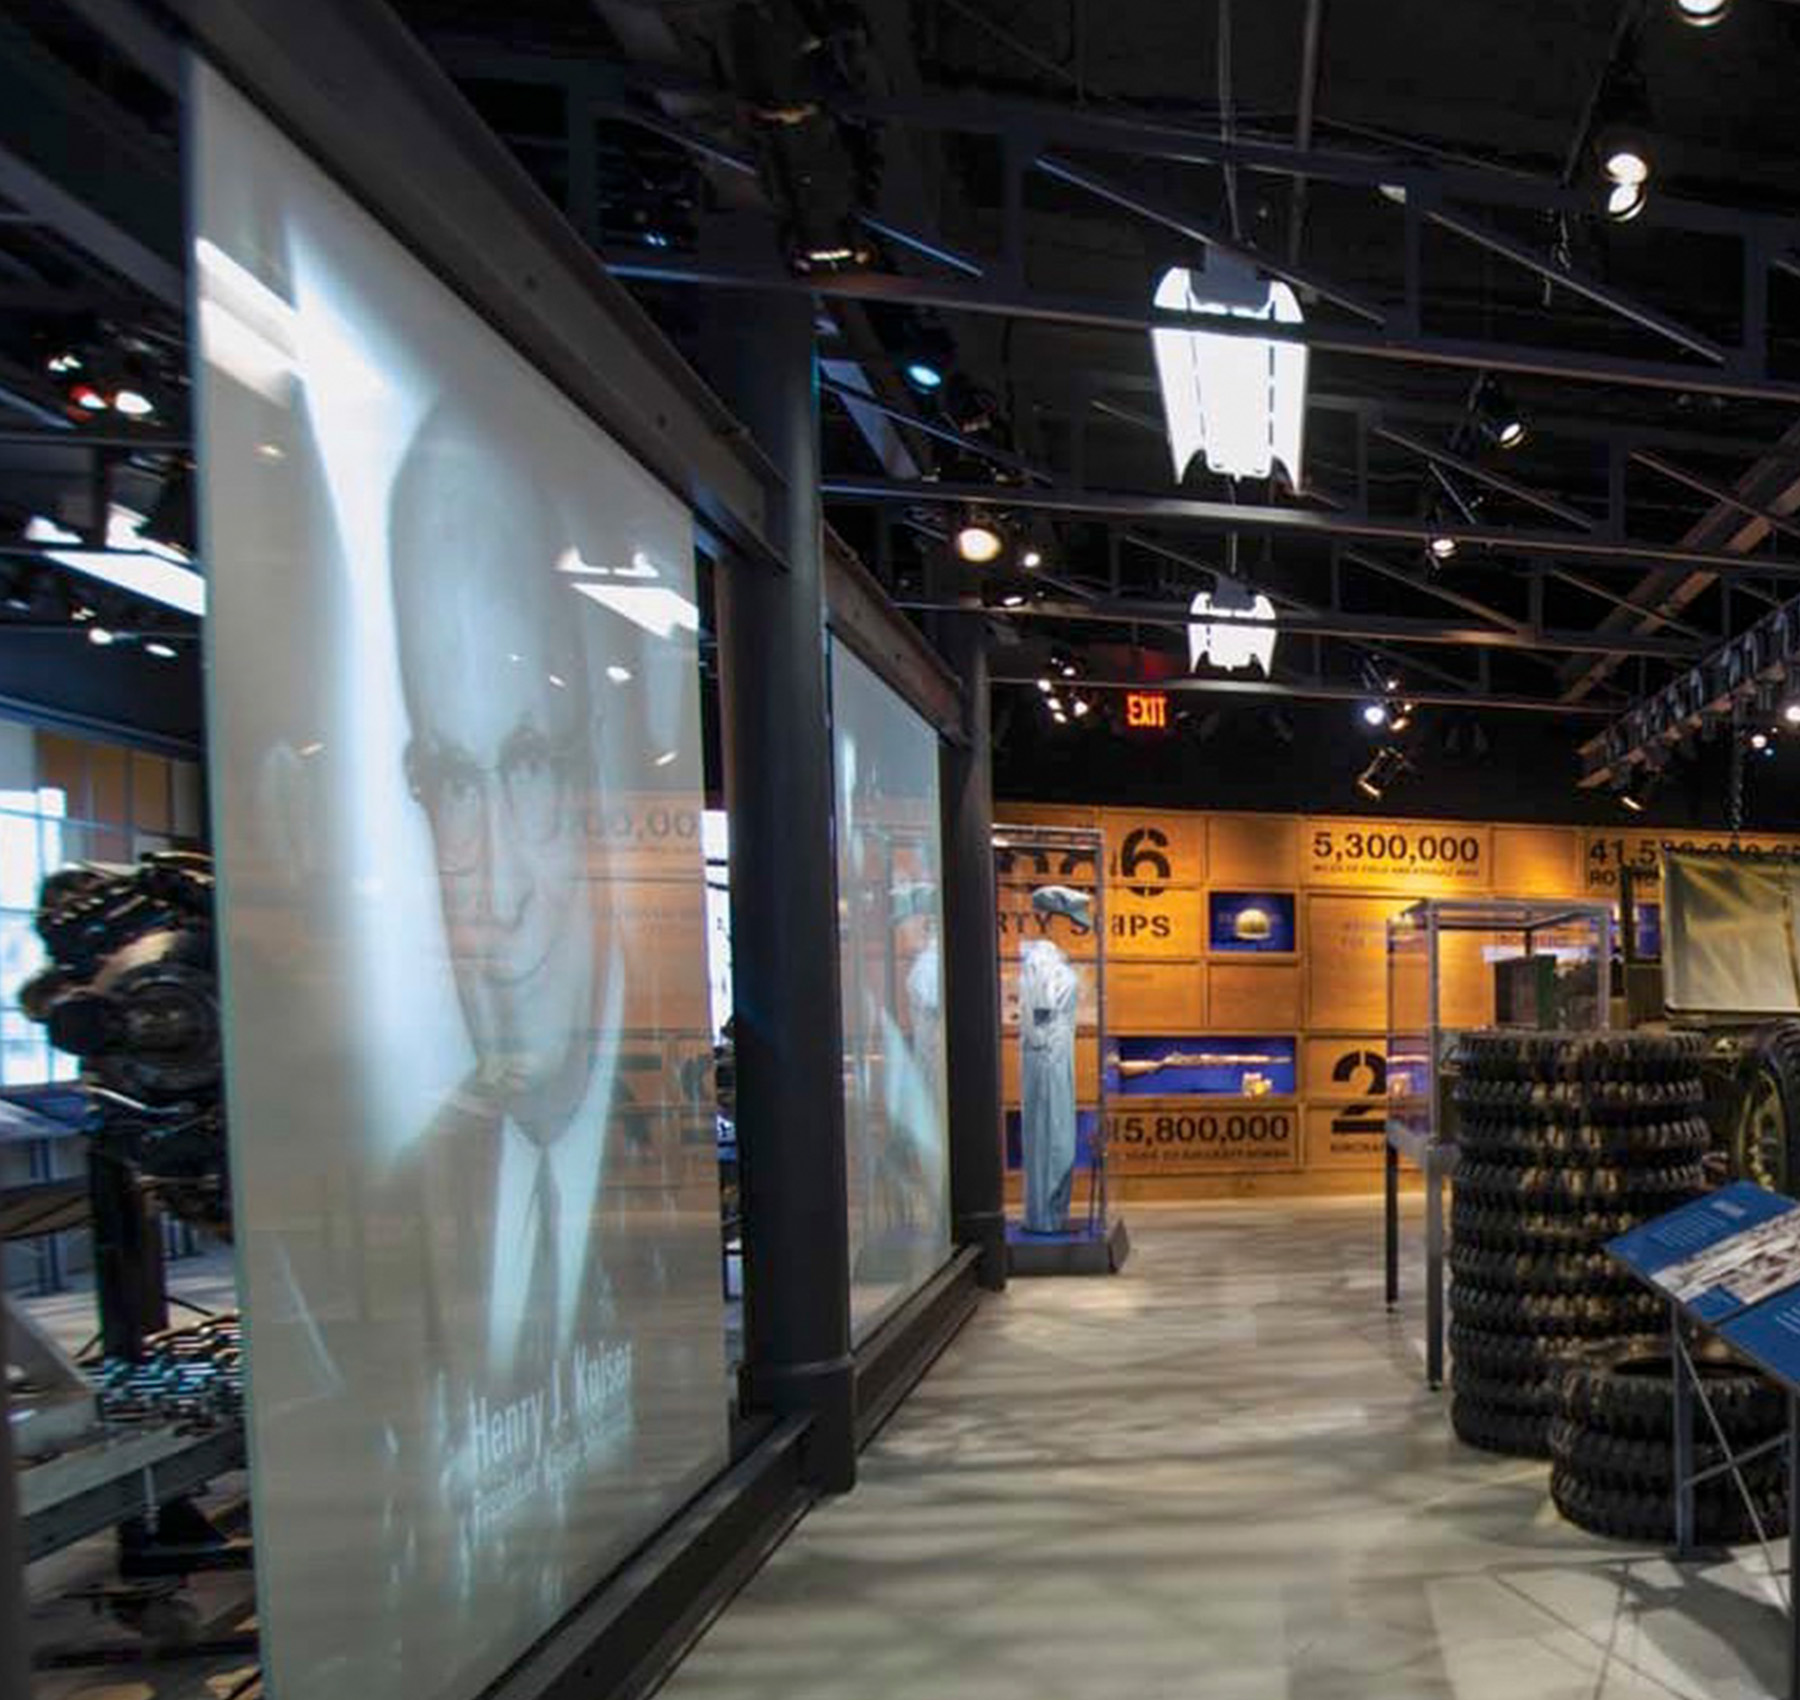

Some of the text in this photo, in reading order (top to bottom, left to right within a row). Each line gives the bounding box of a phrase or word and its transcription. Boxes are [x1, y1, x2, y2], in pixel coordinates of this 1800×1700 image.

[1126, 693, 1167, 727] EXIT
[1312, 831, 1480, 866] 5,300,000
[468, 1388, 546, 1472] Henry
[573, 1339, 632, 1416] Kaiser
